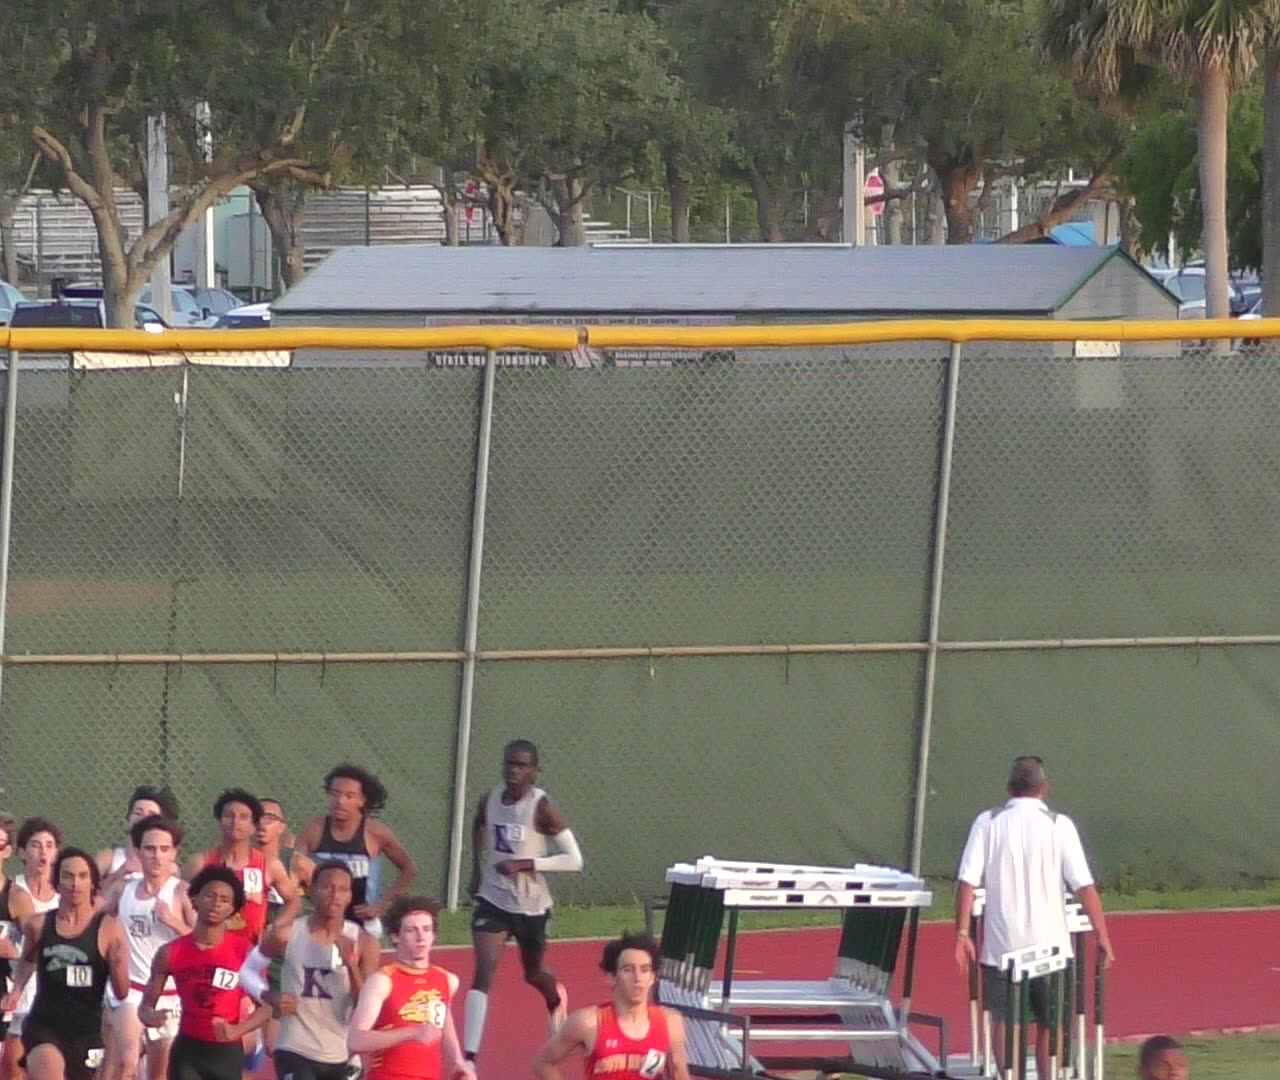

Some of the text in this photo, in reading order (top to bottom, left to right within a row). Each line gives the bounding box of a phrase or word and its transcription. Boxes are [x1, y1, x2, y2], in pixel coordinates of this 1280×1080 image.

[467, 354, 549, 366] CHAPIONSHIPS
[247, 871, 259, 888] 9
[73, 966, 88, 983] 10
[219, 970, 235, 989] 12
[302, 967, 334, 1000] K
[645, 1054, 661, 1075] 2
